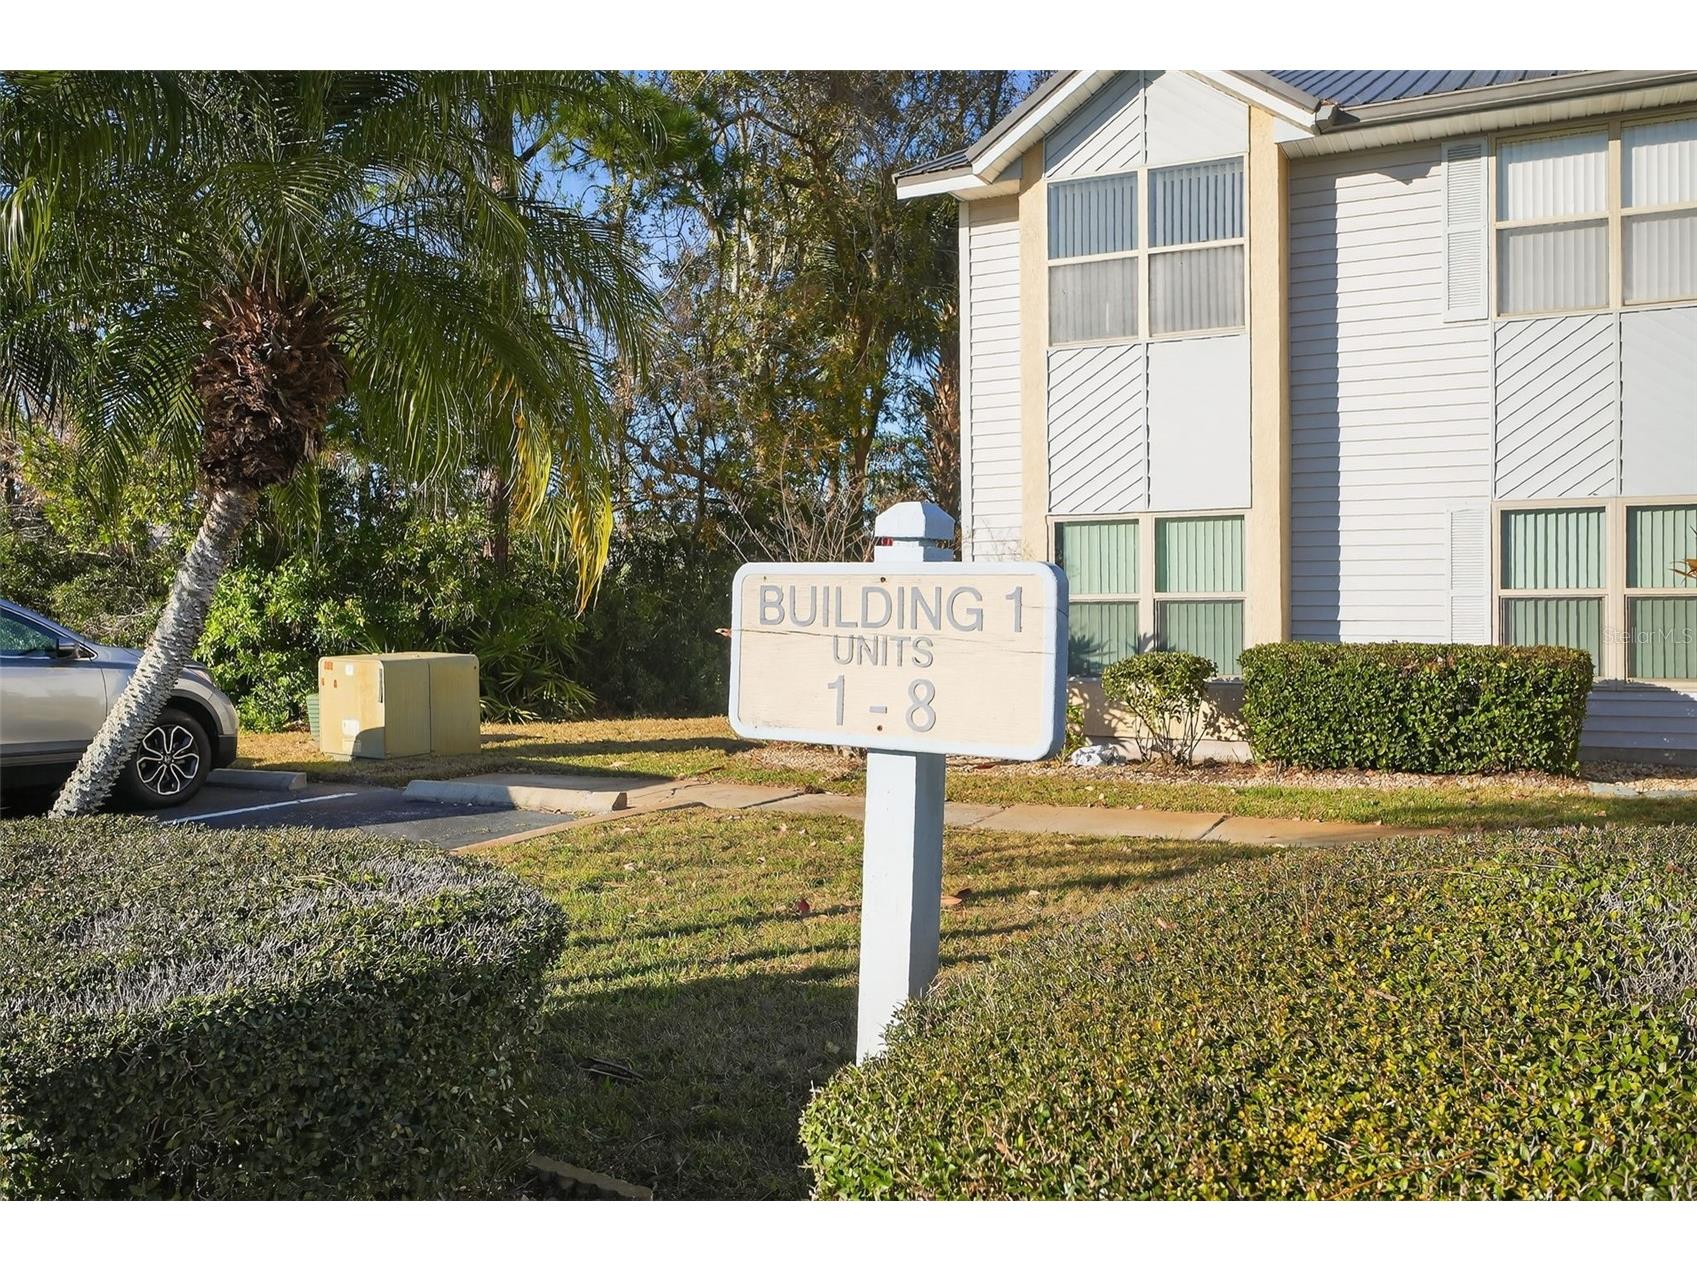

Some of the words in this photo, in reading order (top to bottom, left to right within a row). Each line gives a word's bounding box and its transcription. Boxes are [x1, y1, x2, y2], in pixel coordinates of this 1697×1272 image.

[759, 585, 983, 632] BUILDING
[1006, 586, 1022, 632] 1
[833, 635, 934, 668] UNITS
[828, 675, 845, 726] 1
[869, 706, 888, 714] -
[905, 678, 936, 732] 8
